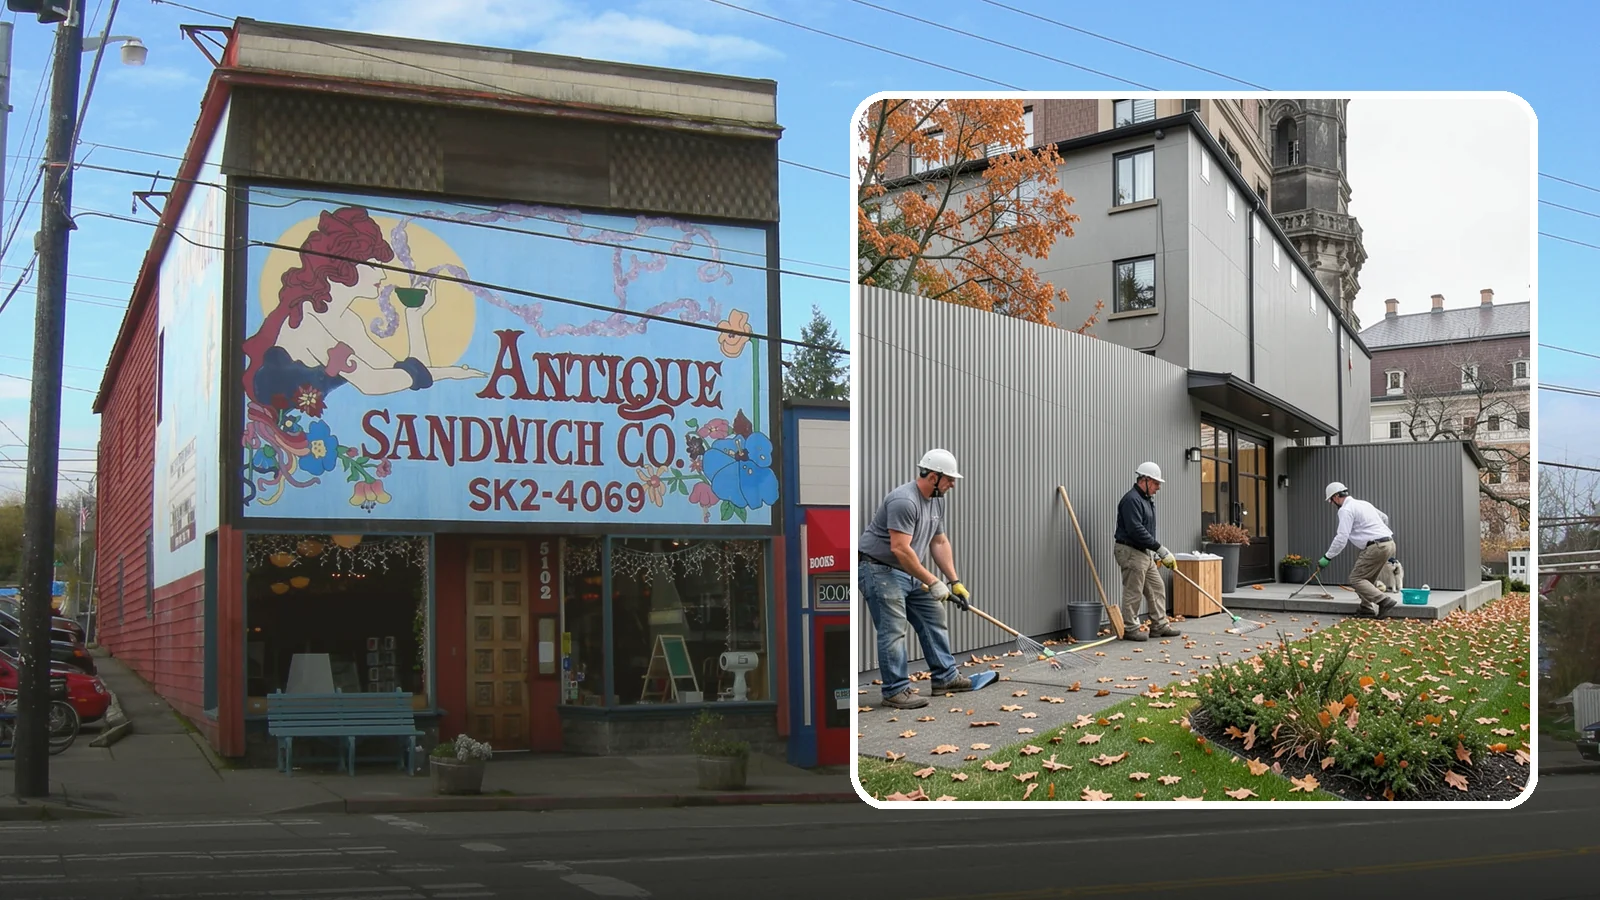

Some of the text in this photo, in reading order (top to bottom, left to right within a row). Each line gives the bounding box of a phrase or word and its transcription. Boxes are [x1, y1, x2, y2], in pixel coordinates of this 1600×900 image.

[475, 328, 724, 421] ANTIQUE
[361, 408, 685, 469] SANDWICH CO.
[468, 477, 646, 513] SK2-4069
[540, 542, 551, 600] 5102
[809, 555, 835, 569] BOOKS
